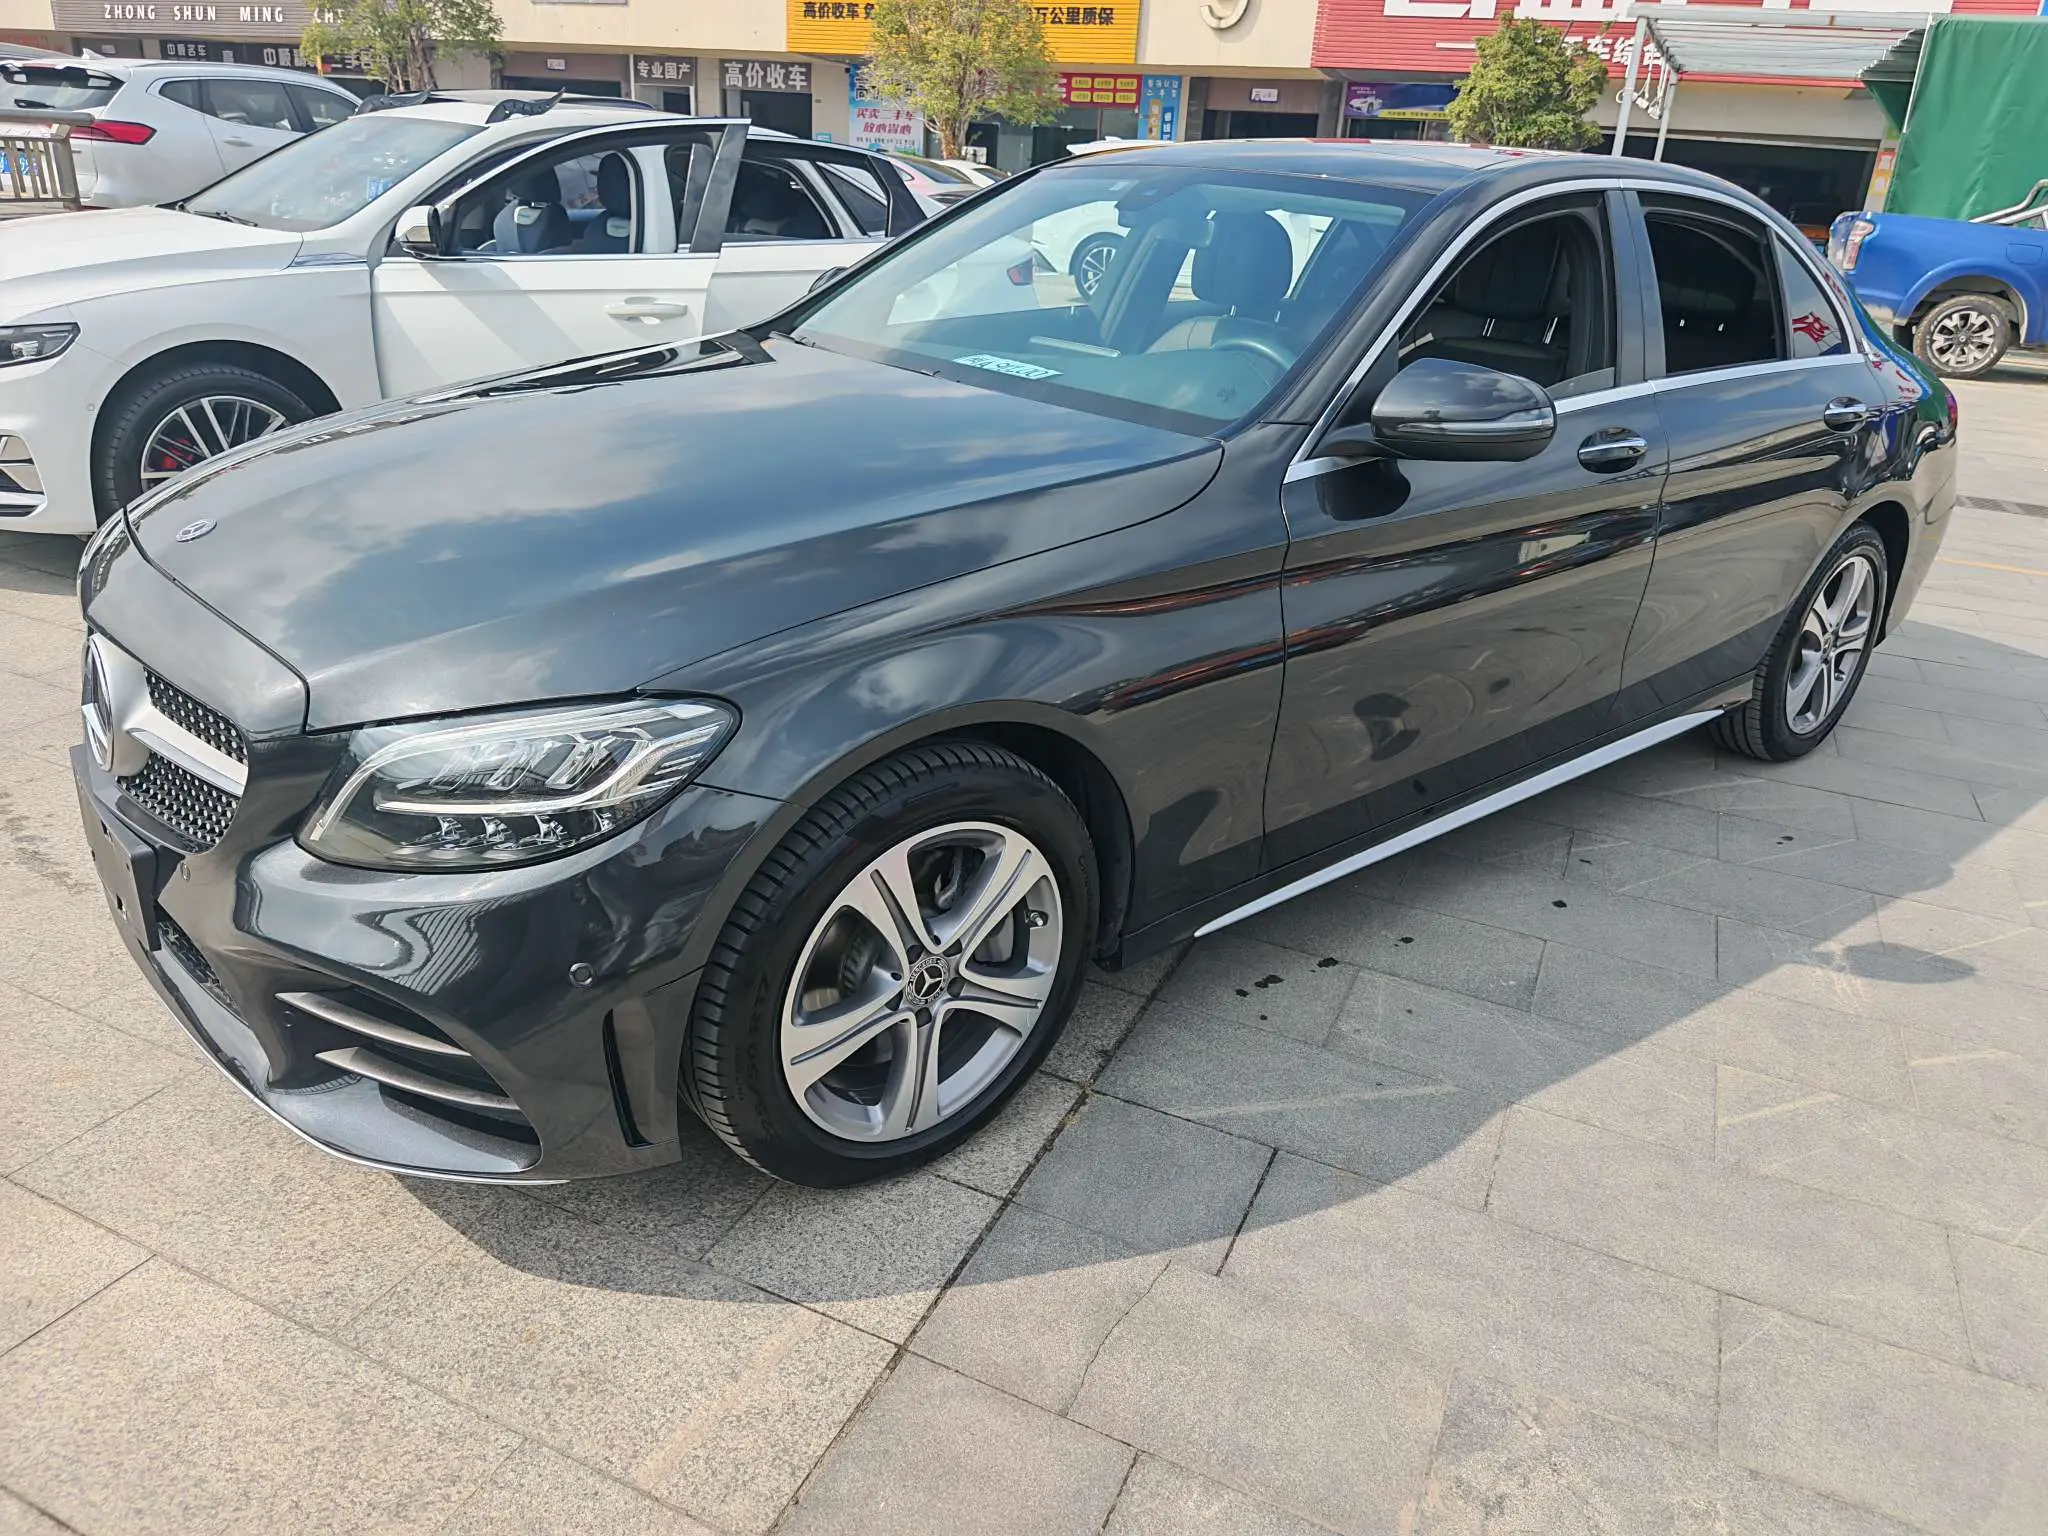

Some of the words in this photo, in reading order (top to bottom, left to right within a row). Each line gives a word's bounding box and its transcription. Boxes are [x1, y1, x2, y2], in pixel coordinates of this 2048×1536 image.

[104, 4, 156, 20] ZHONG
[174, 6, 216, 21] SHUN
[239, 6, 283, 23] MING
[803, 2, 859, 20] 高价收车
[1028, 7, 1114, 26] 万公里质保
[1562, 35, 1663, 65] 车综合
[636, 60, 691, 80] 专业国产
[724, 61, 808, 91] 高价收车
